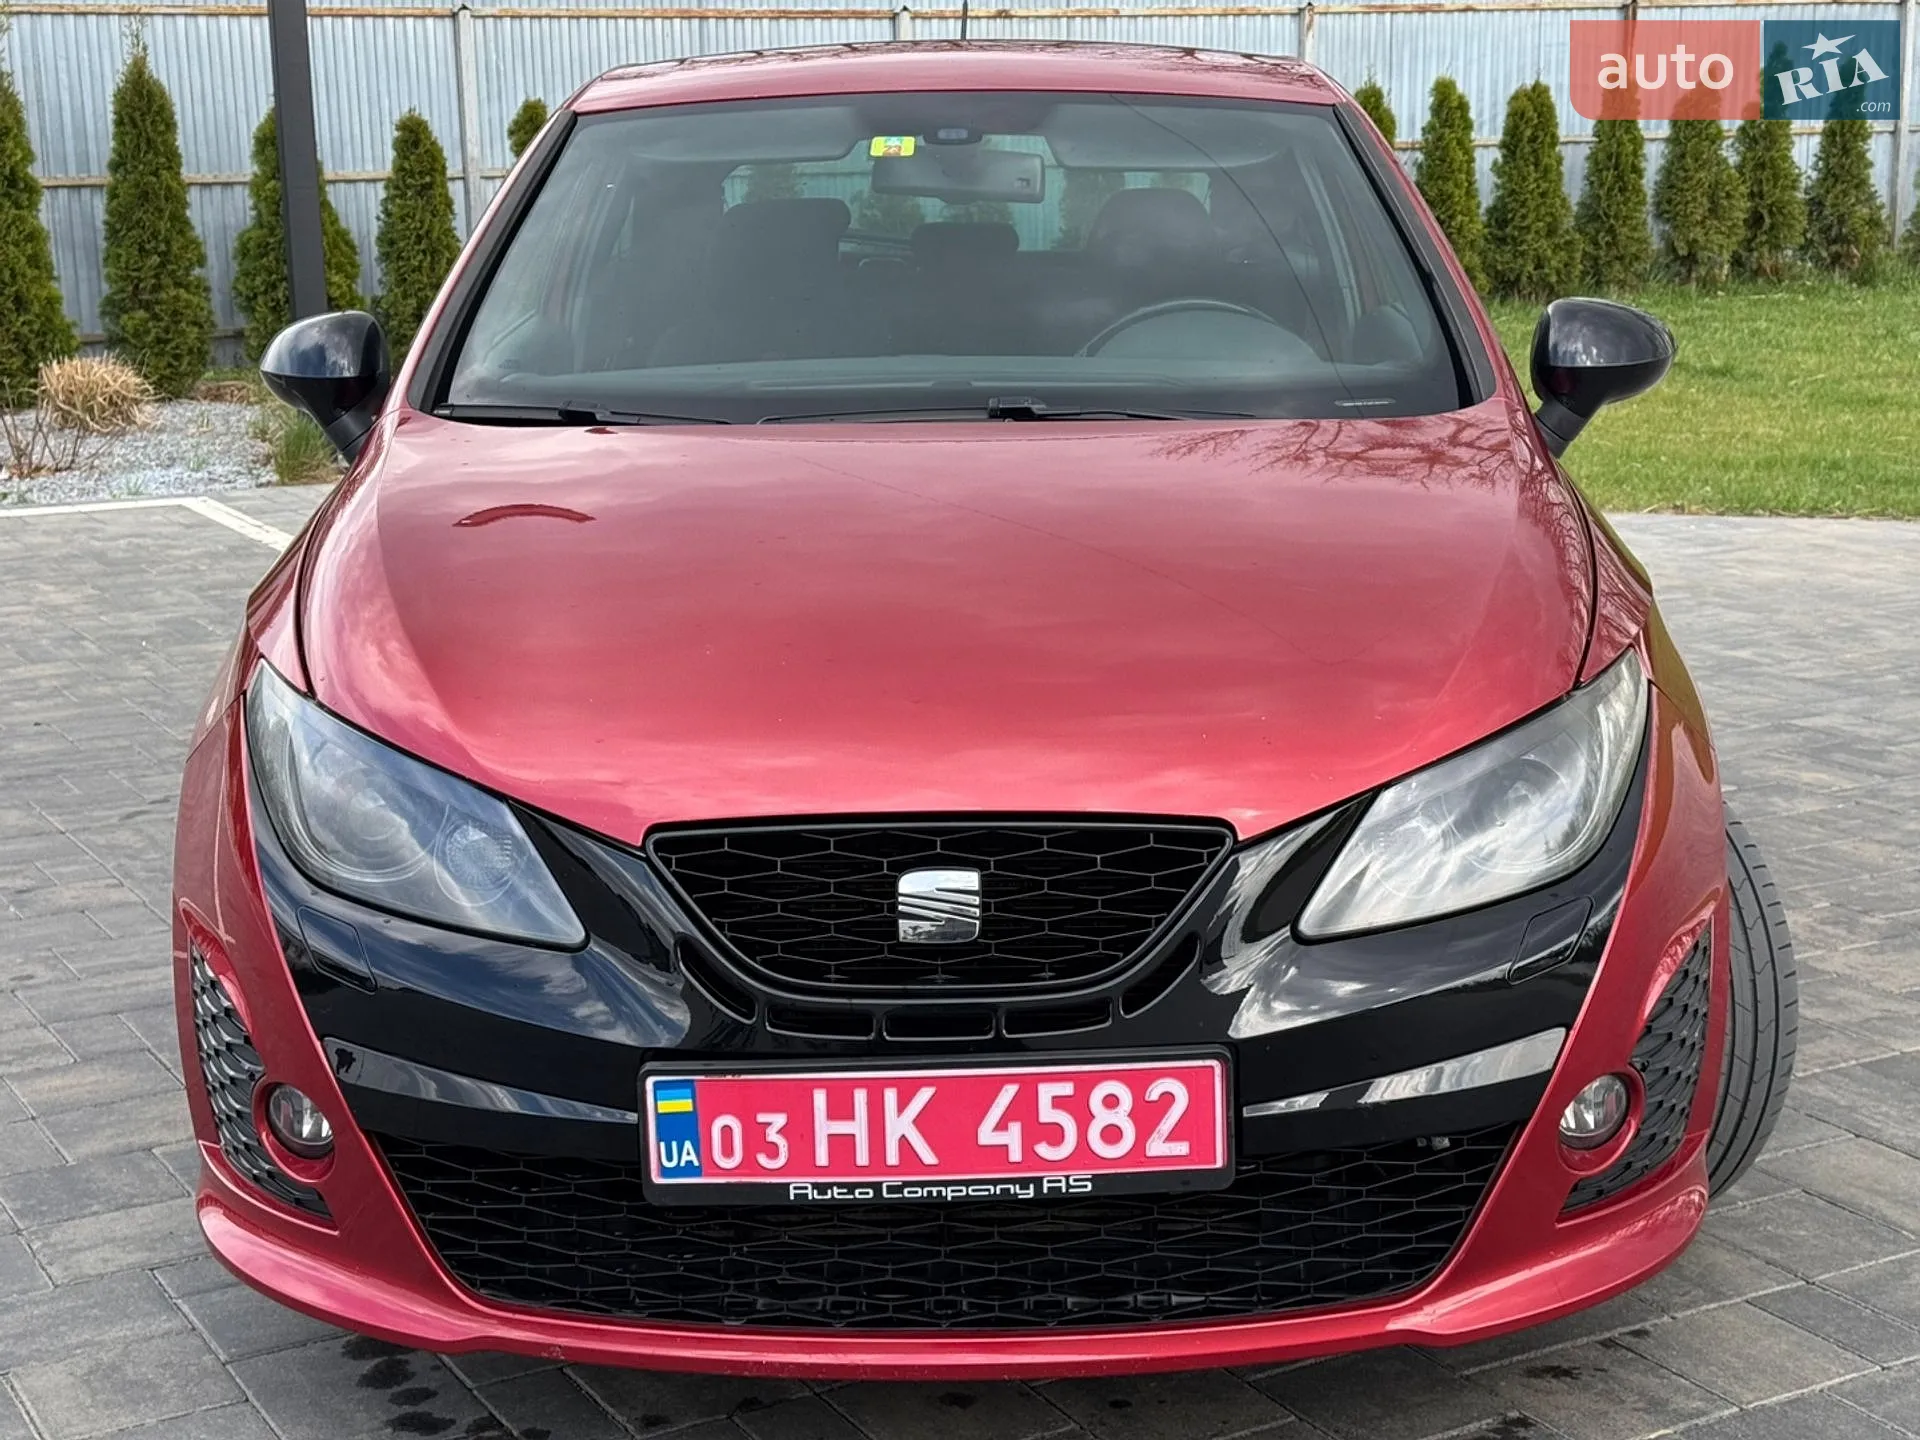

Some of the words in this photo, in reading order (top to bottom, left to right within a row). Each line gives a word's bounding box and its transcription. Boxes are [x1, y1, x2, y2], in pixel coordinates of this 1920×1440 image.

[710, 1112, 789, 1170] 03
[813, 1086, 938, 1167] HK
[977, 1077, 1190, 1164] 4582
[660, 1140, 699, 1168] UA
[789, 1183, 874, 1200] Auto
[882, 1180, 1034, 1200] Company
[1043, 1175, 1092, 1194] AS
